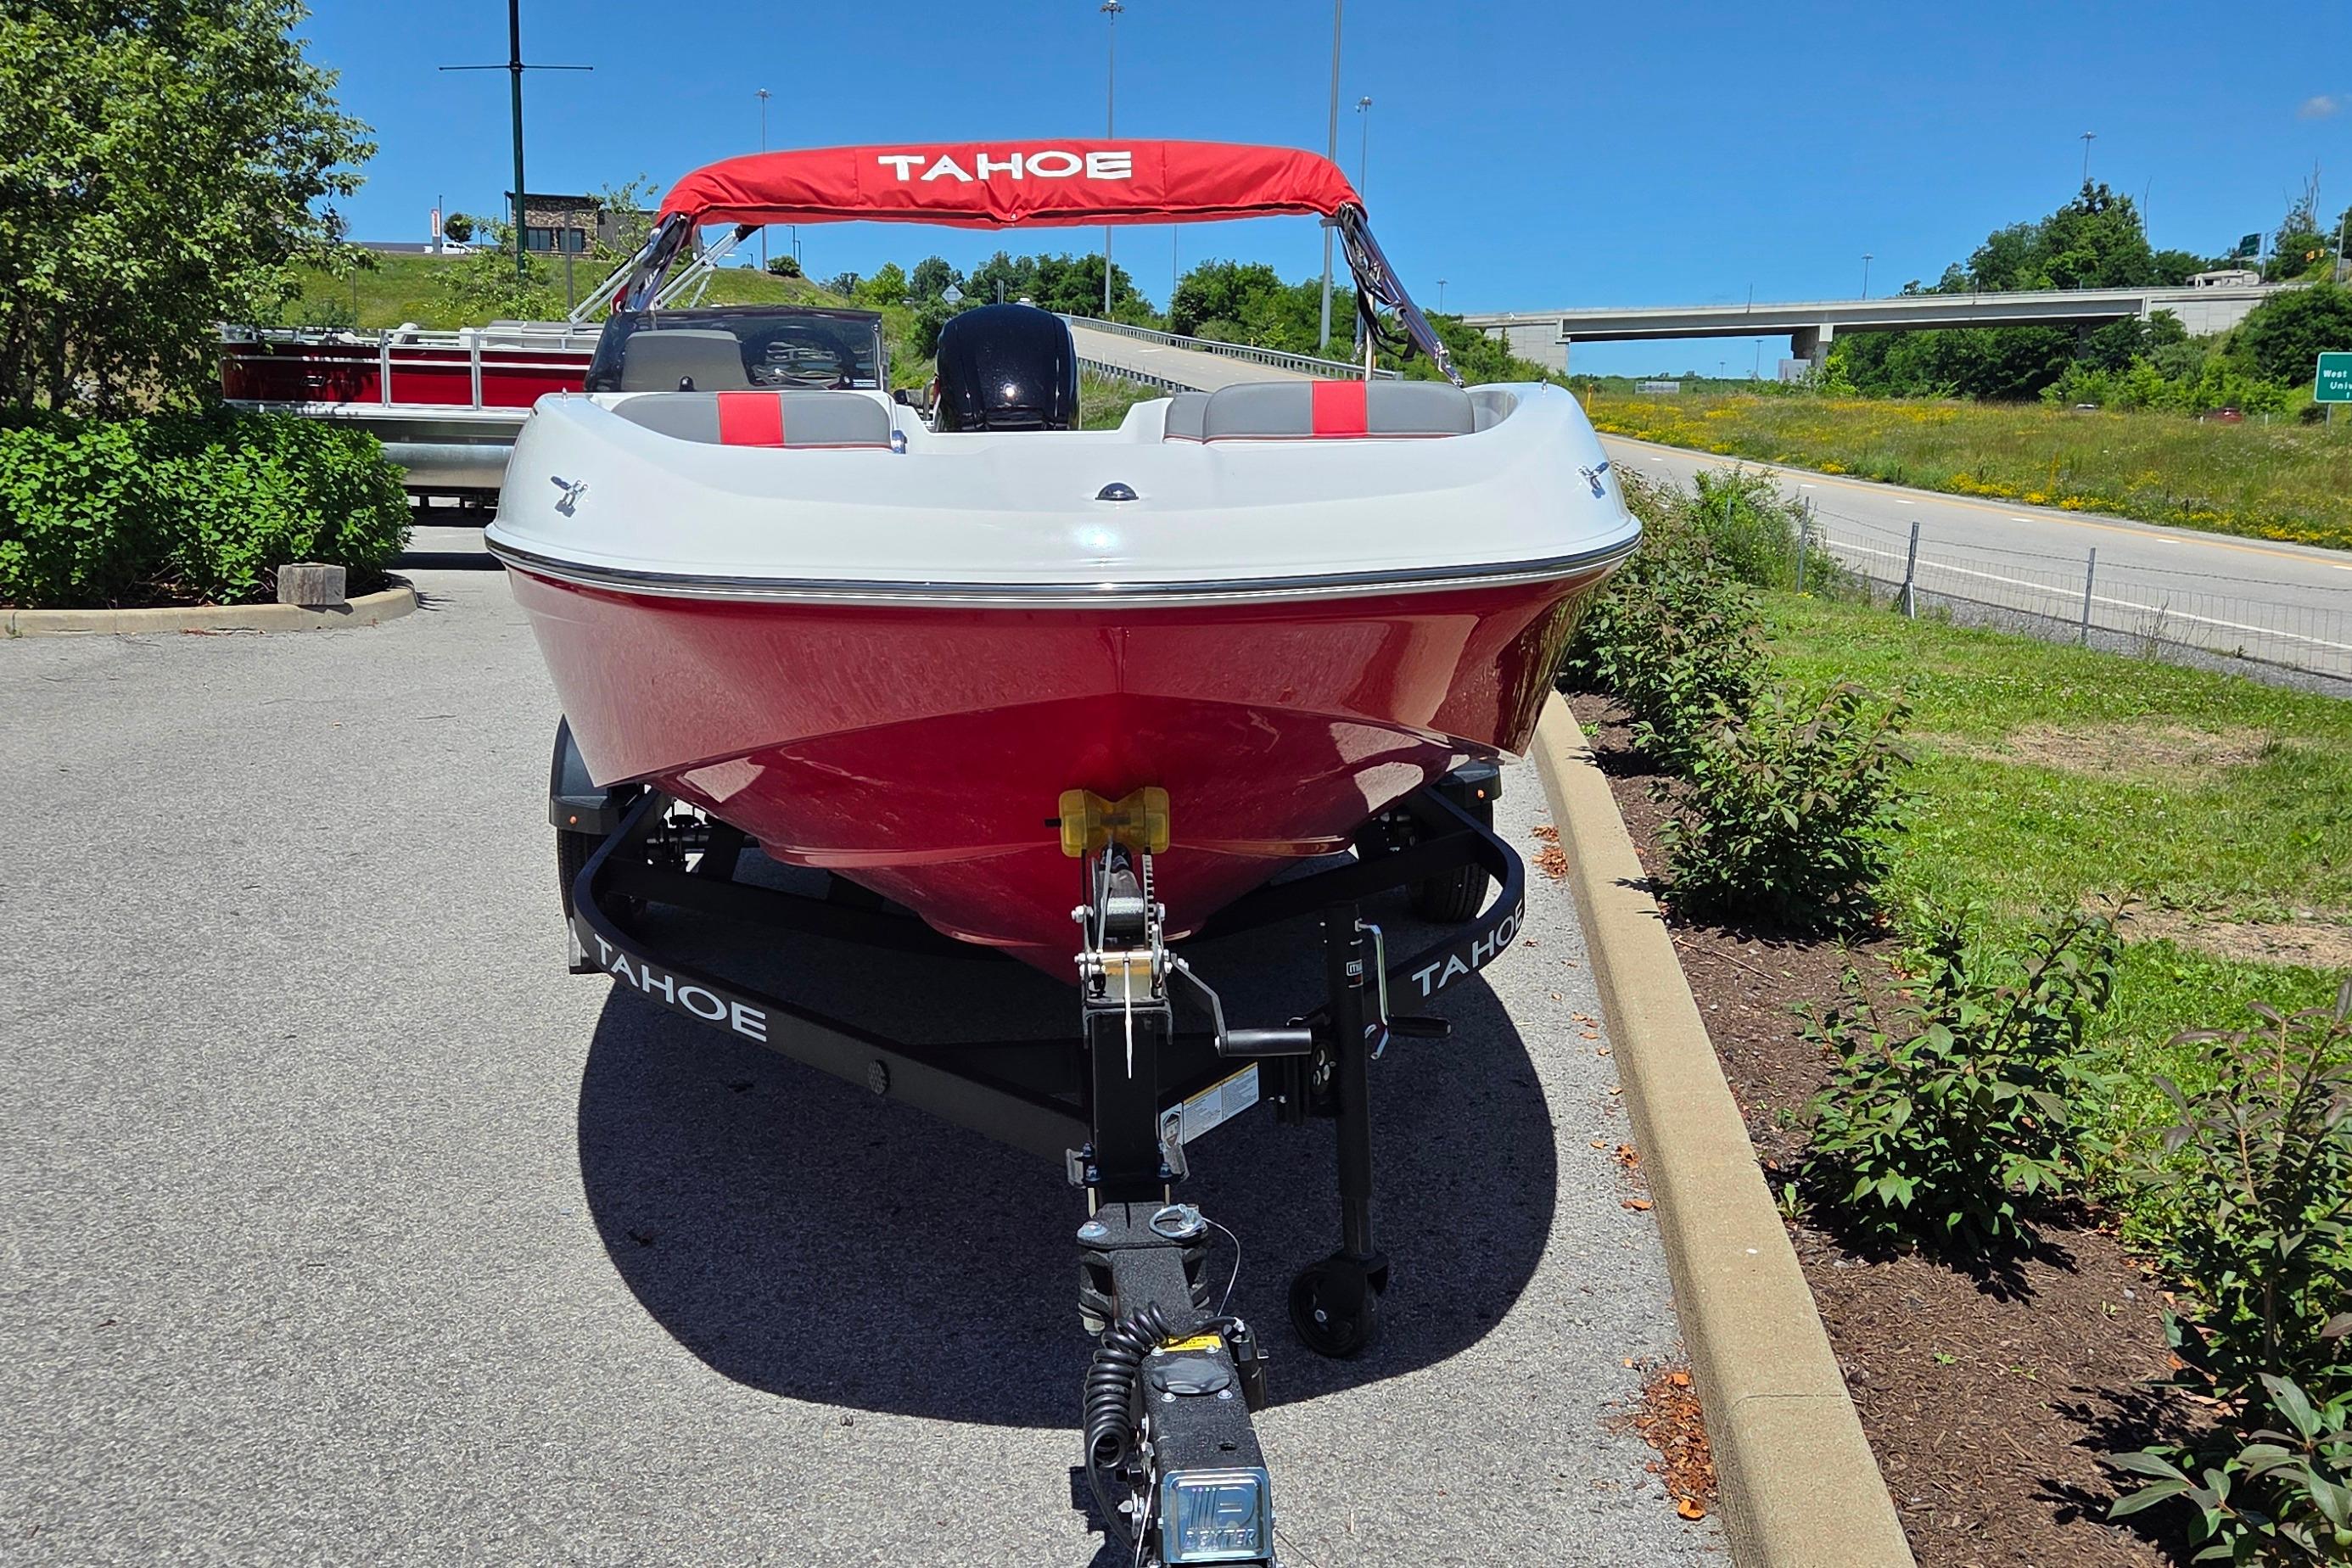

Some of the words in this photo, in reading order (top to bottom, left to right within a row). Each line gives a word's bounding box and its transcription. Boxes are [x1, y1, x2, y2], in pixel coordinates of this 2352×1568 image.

[878, 151, 1132, 182] TAHOE
[2323, 369, 2348, 378] West
[1412, 899, 1523, 997] TAHOE
[594, 933, 767, 1042] TAHOE
